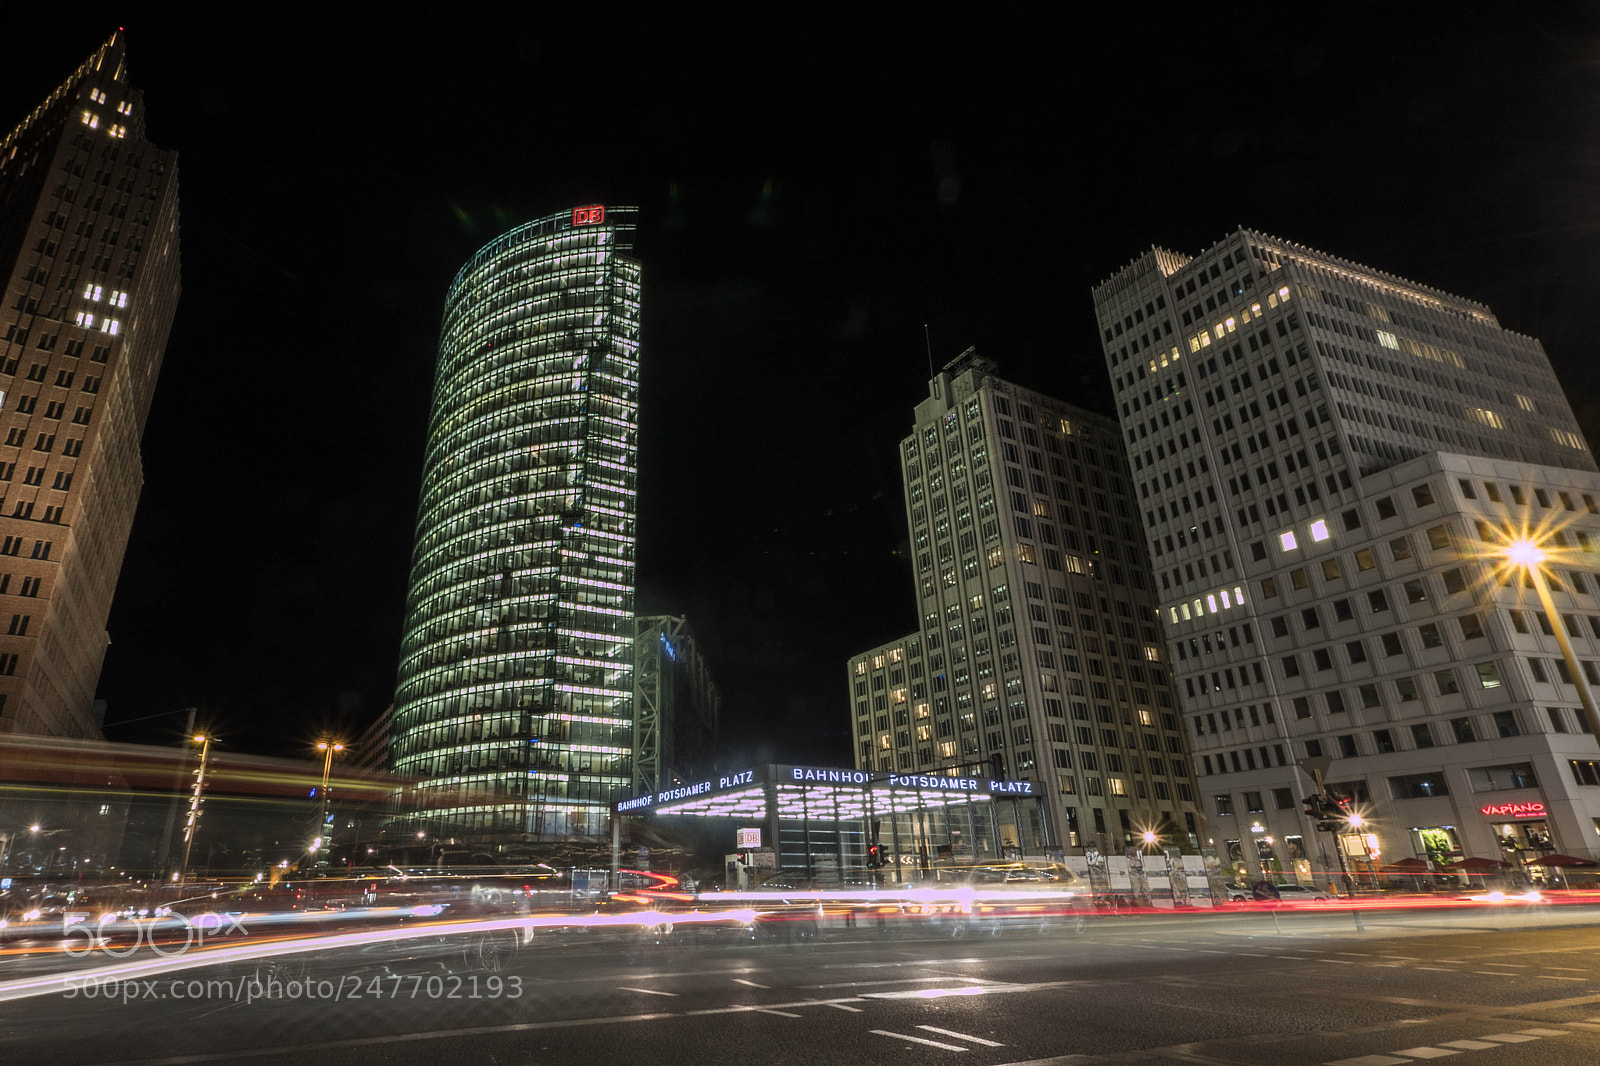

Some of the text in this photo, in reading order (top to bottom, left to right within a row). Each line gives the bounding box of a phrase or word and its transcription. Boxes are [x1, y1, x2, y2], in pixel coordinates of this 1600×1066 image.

[576, 208, 601, 224] DB
[617, 770, 753, 812] BAHNHOF POTSDAMER PLATZ
[889, 774, 978, 790] POTSDAMER
[990, 781, 1032, 793] PLATZ
